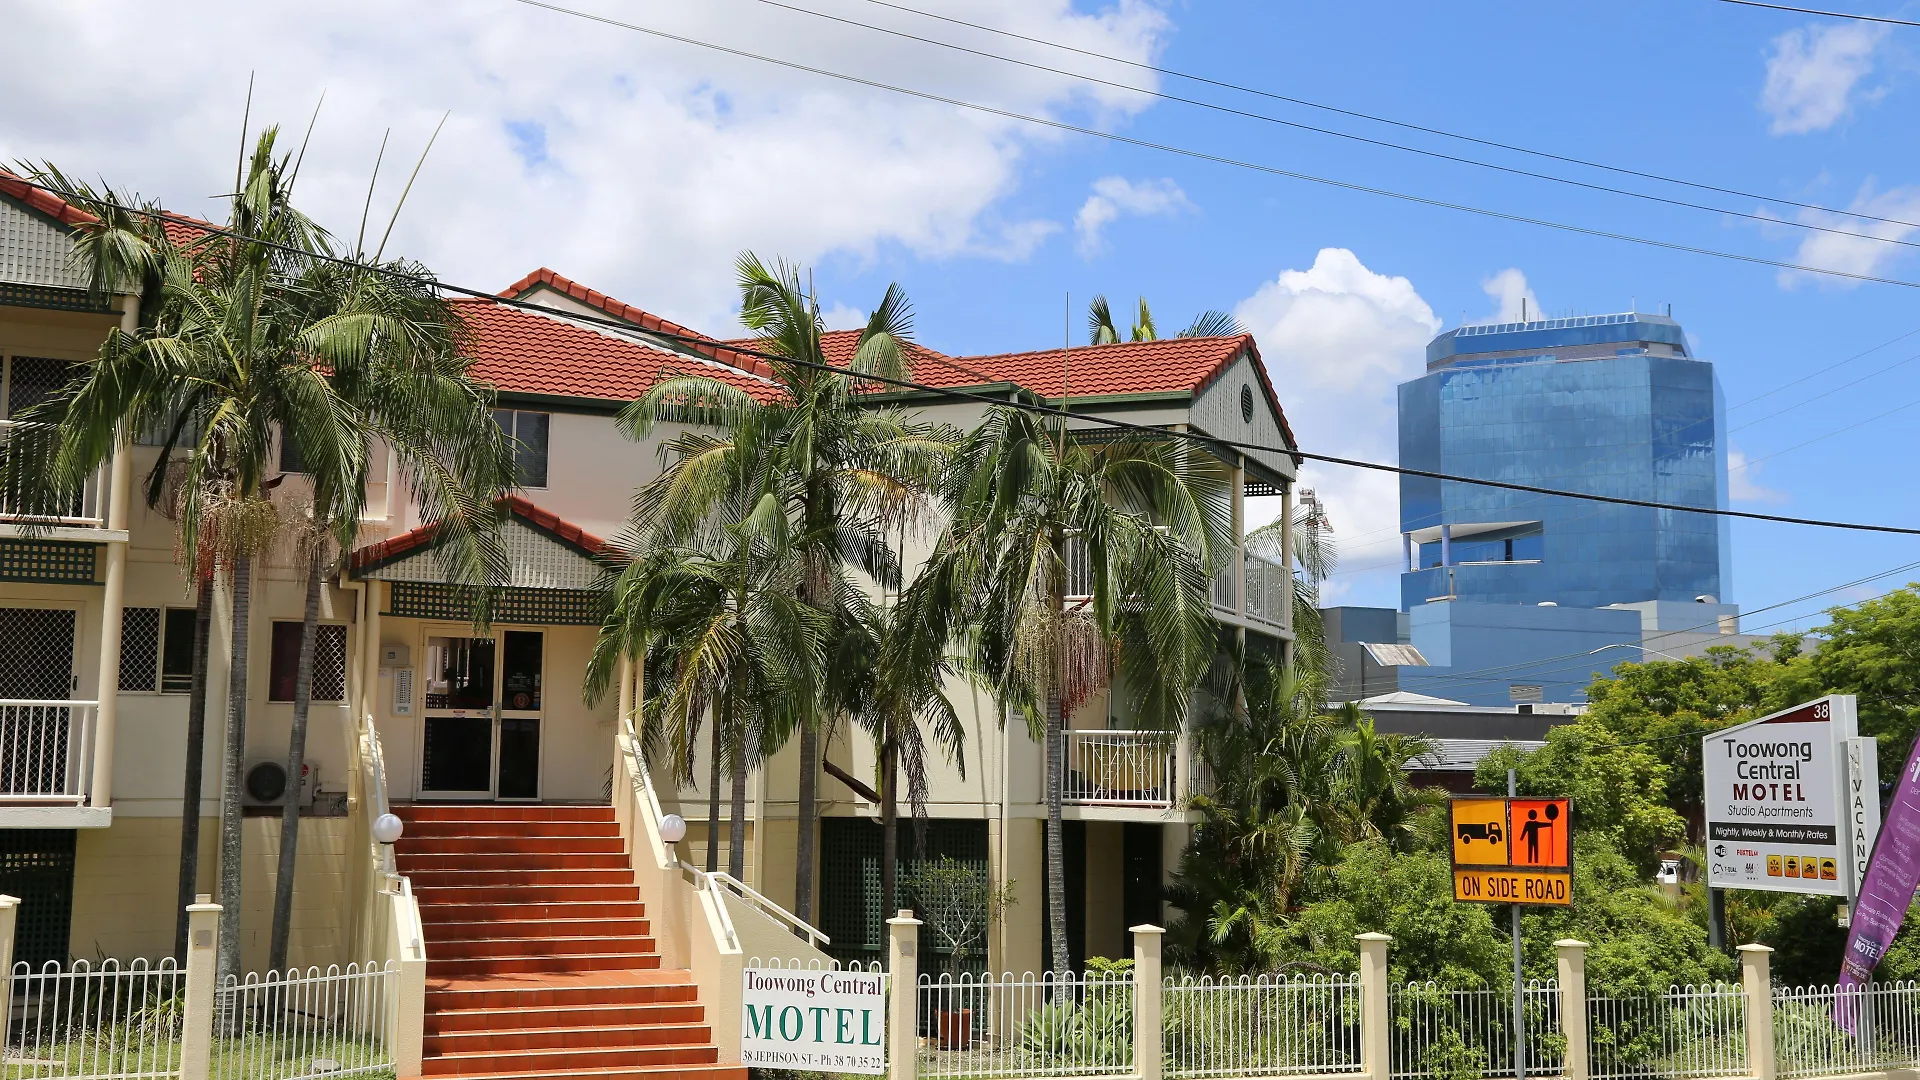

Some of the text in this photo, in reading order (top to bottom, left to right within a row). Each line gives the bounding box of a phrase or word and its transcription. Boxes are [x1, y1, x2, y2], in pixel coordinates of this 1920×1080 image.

[1813, 704, 1829, 719] 38
[1723, 738, 1812, 763] Toowong
[1736, 760, 1801, 780] Central
[1733, 783, 1806, 802] MOTEL
[1727, 804, 1813, 818] Studio Apartments
[1715, 826, 1828, 841] Nightly, Weekly & Monthly Rates
[1462, 876, 1565, 900] ON SIDE ROAD
[1853, 939, 1880, 961] MOTEL
[745, 971, 882, 998] Toowong Central
[743, 1003, 882, 1046] MOTEL
[742, 1050, 753, 1062] 38
[754, 1051, 799, 1064] JEPHSON
[801, 1053, 814, 1065] ST
[820, 1054, 832, 1066] Ph
[833, 1055, 844, 1067] 38
[846, 1056, 856, 1067] 70
[857, 1057, 869, 1068] 35
[870, 1057, 881, 1069] 22
